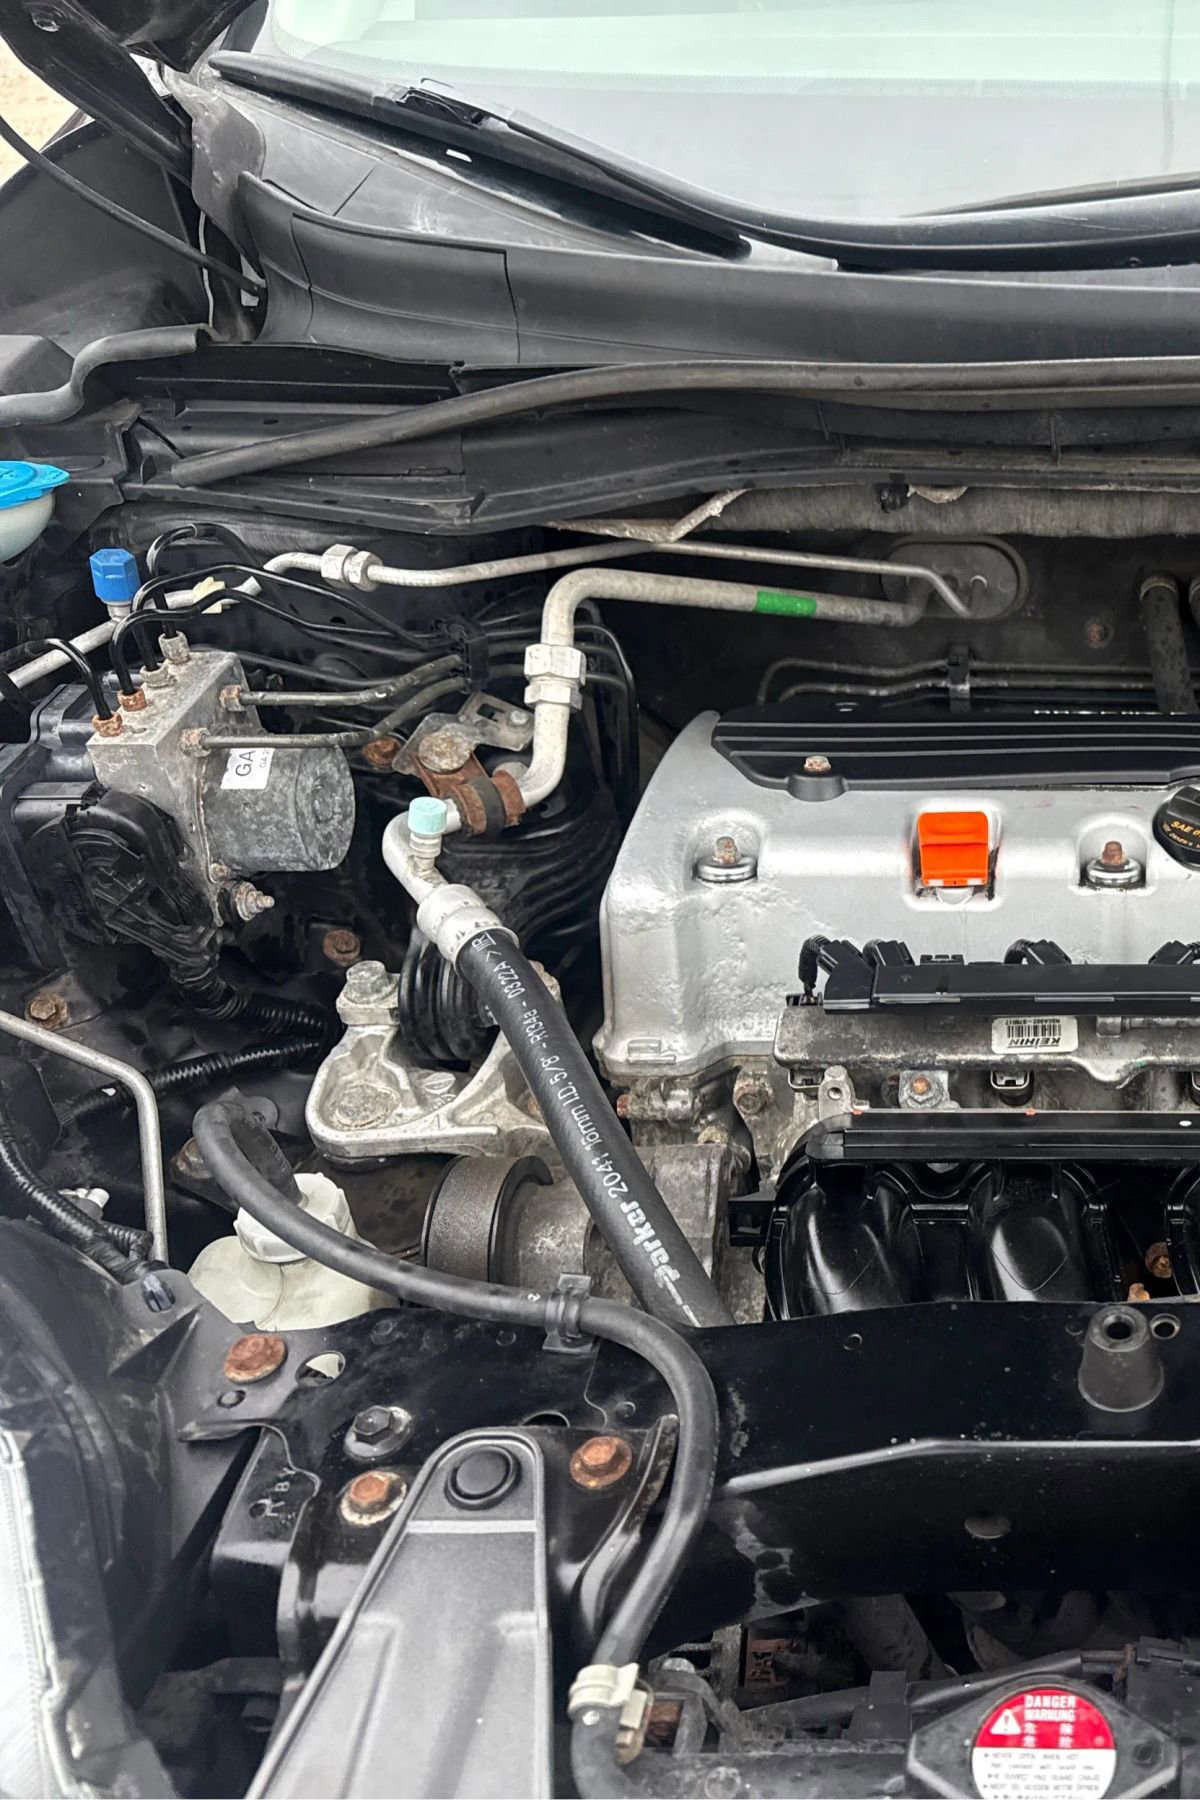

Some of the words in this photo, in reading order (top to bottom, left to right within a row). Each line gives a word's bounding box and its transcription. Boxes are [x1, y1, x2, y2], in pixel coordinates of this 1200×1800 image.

[236, 750, 257, 777] GA
[1170, 820, 1193, 833] SAE
[523, 1008, 550, 1045] R134a
[1008, 1036, 1062, 1049] KEIHIN
[571, 1104, 605, 1152] 16mm
[591, 1152, 629, 1199] 2041
[620, 1200, 681, 1290] Parker
[1024, 1695, 1076, 1709] DANGER
